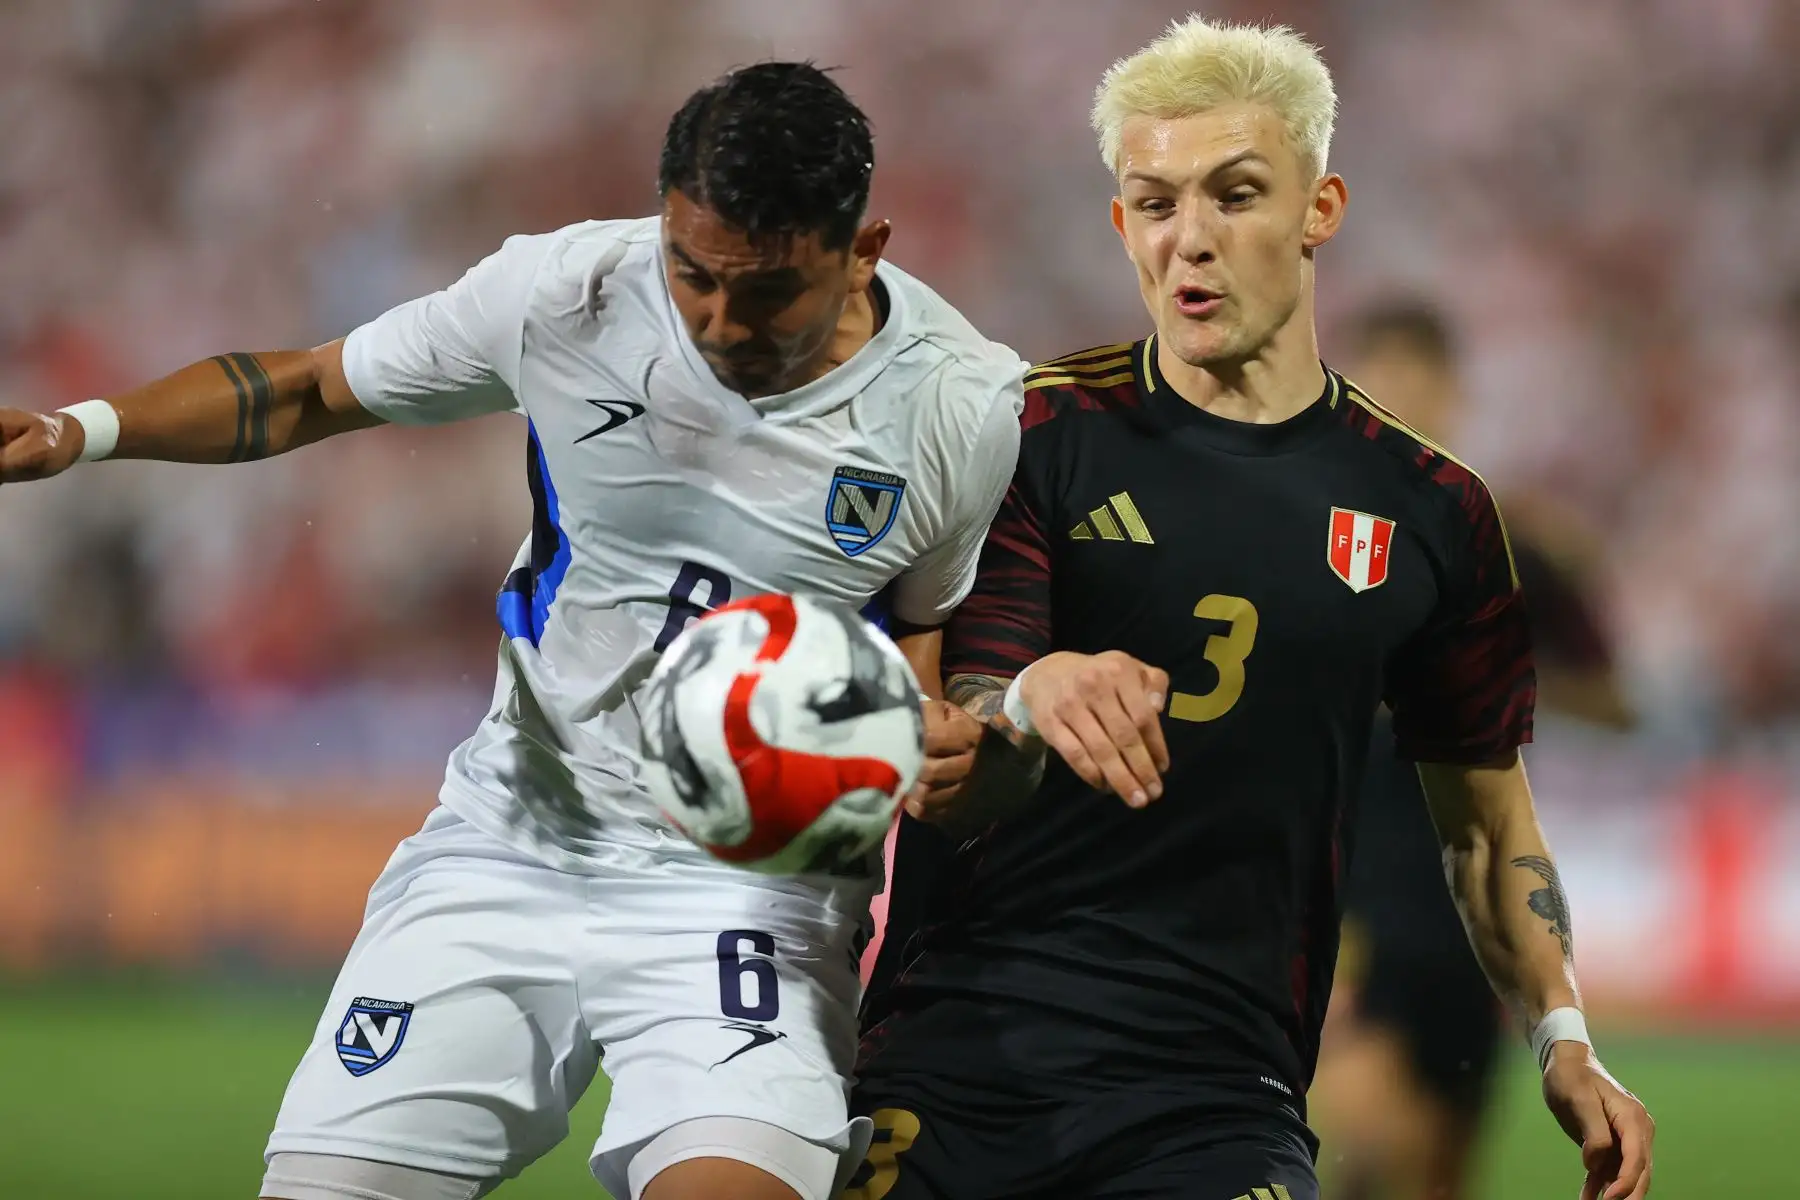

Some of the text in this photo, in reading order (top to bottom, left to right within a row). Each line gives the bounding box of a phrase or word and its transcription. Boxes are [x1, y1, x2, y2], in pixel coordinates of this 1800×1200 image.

[1168, 593, 1259, 722] 3
[716, 929, 780, 1022] 6
[833, 1108, 921, 1200] 3
